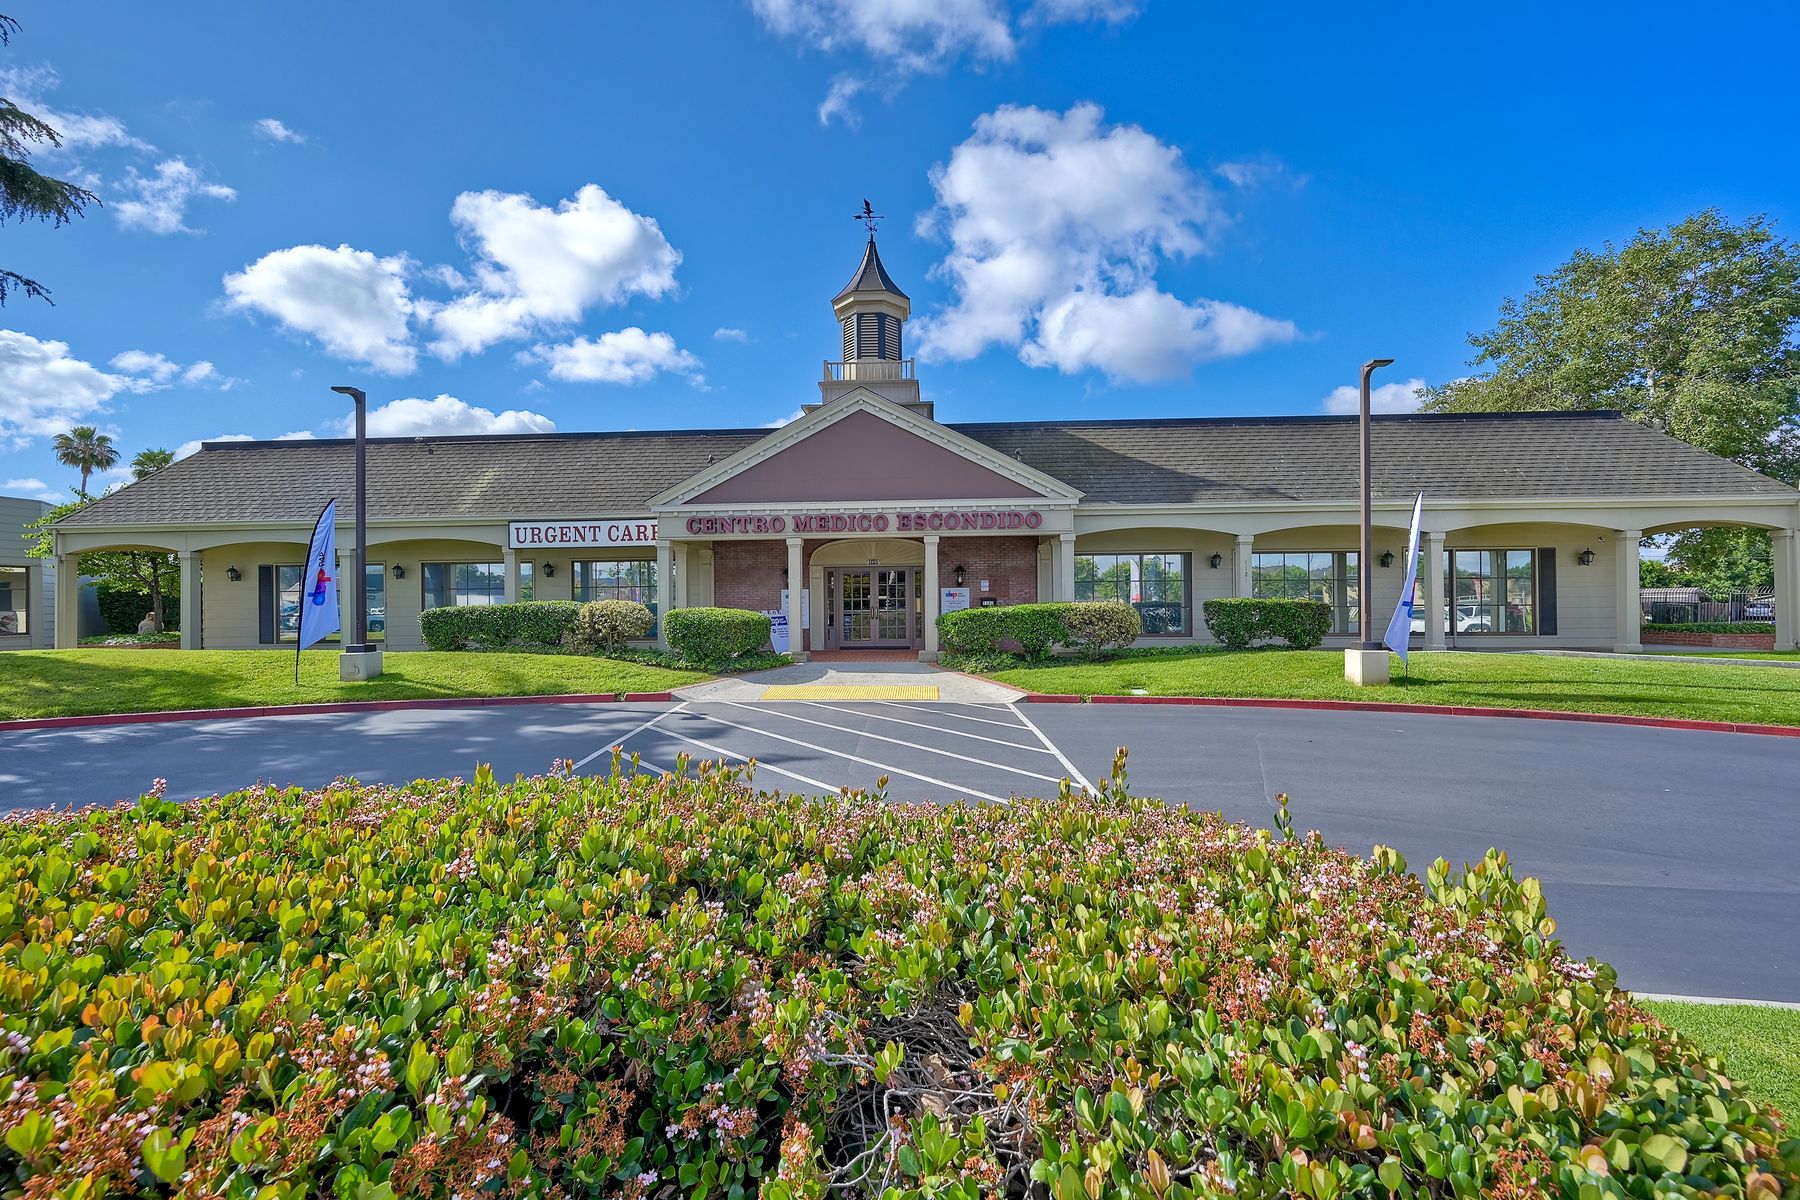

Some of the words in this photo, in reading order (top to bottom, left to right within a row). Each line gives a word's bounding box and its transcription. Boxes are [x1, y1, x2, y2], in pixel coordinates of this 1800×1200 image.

[686, 515, 785, 534] CENTRO
[792, 512, 889, 532] MEDICO
[896, 511, 1042, 531] ESCONDIDO
[515, 526, 600, 543] URGENT
